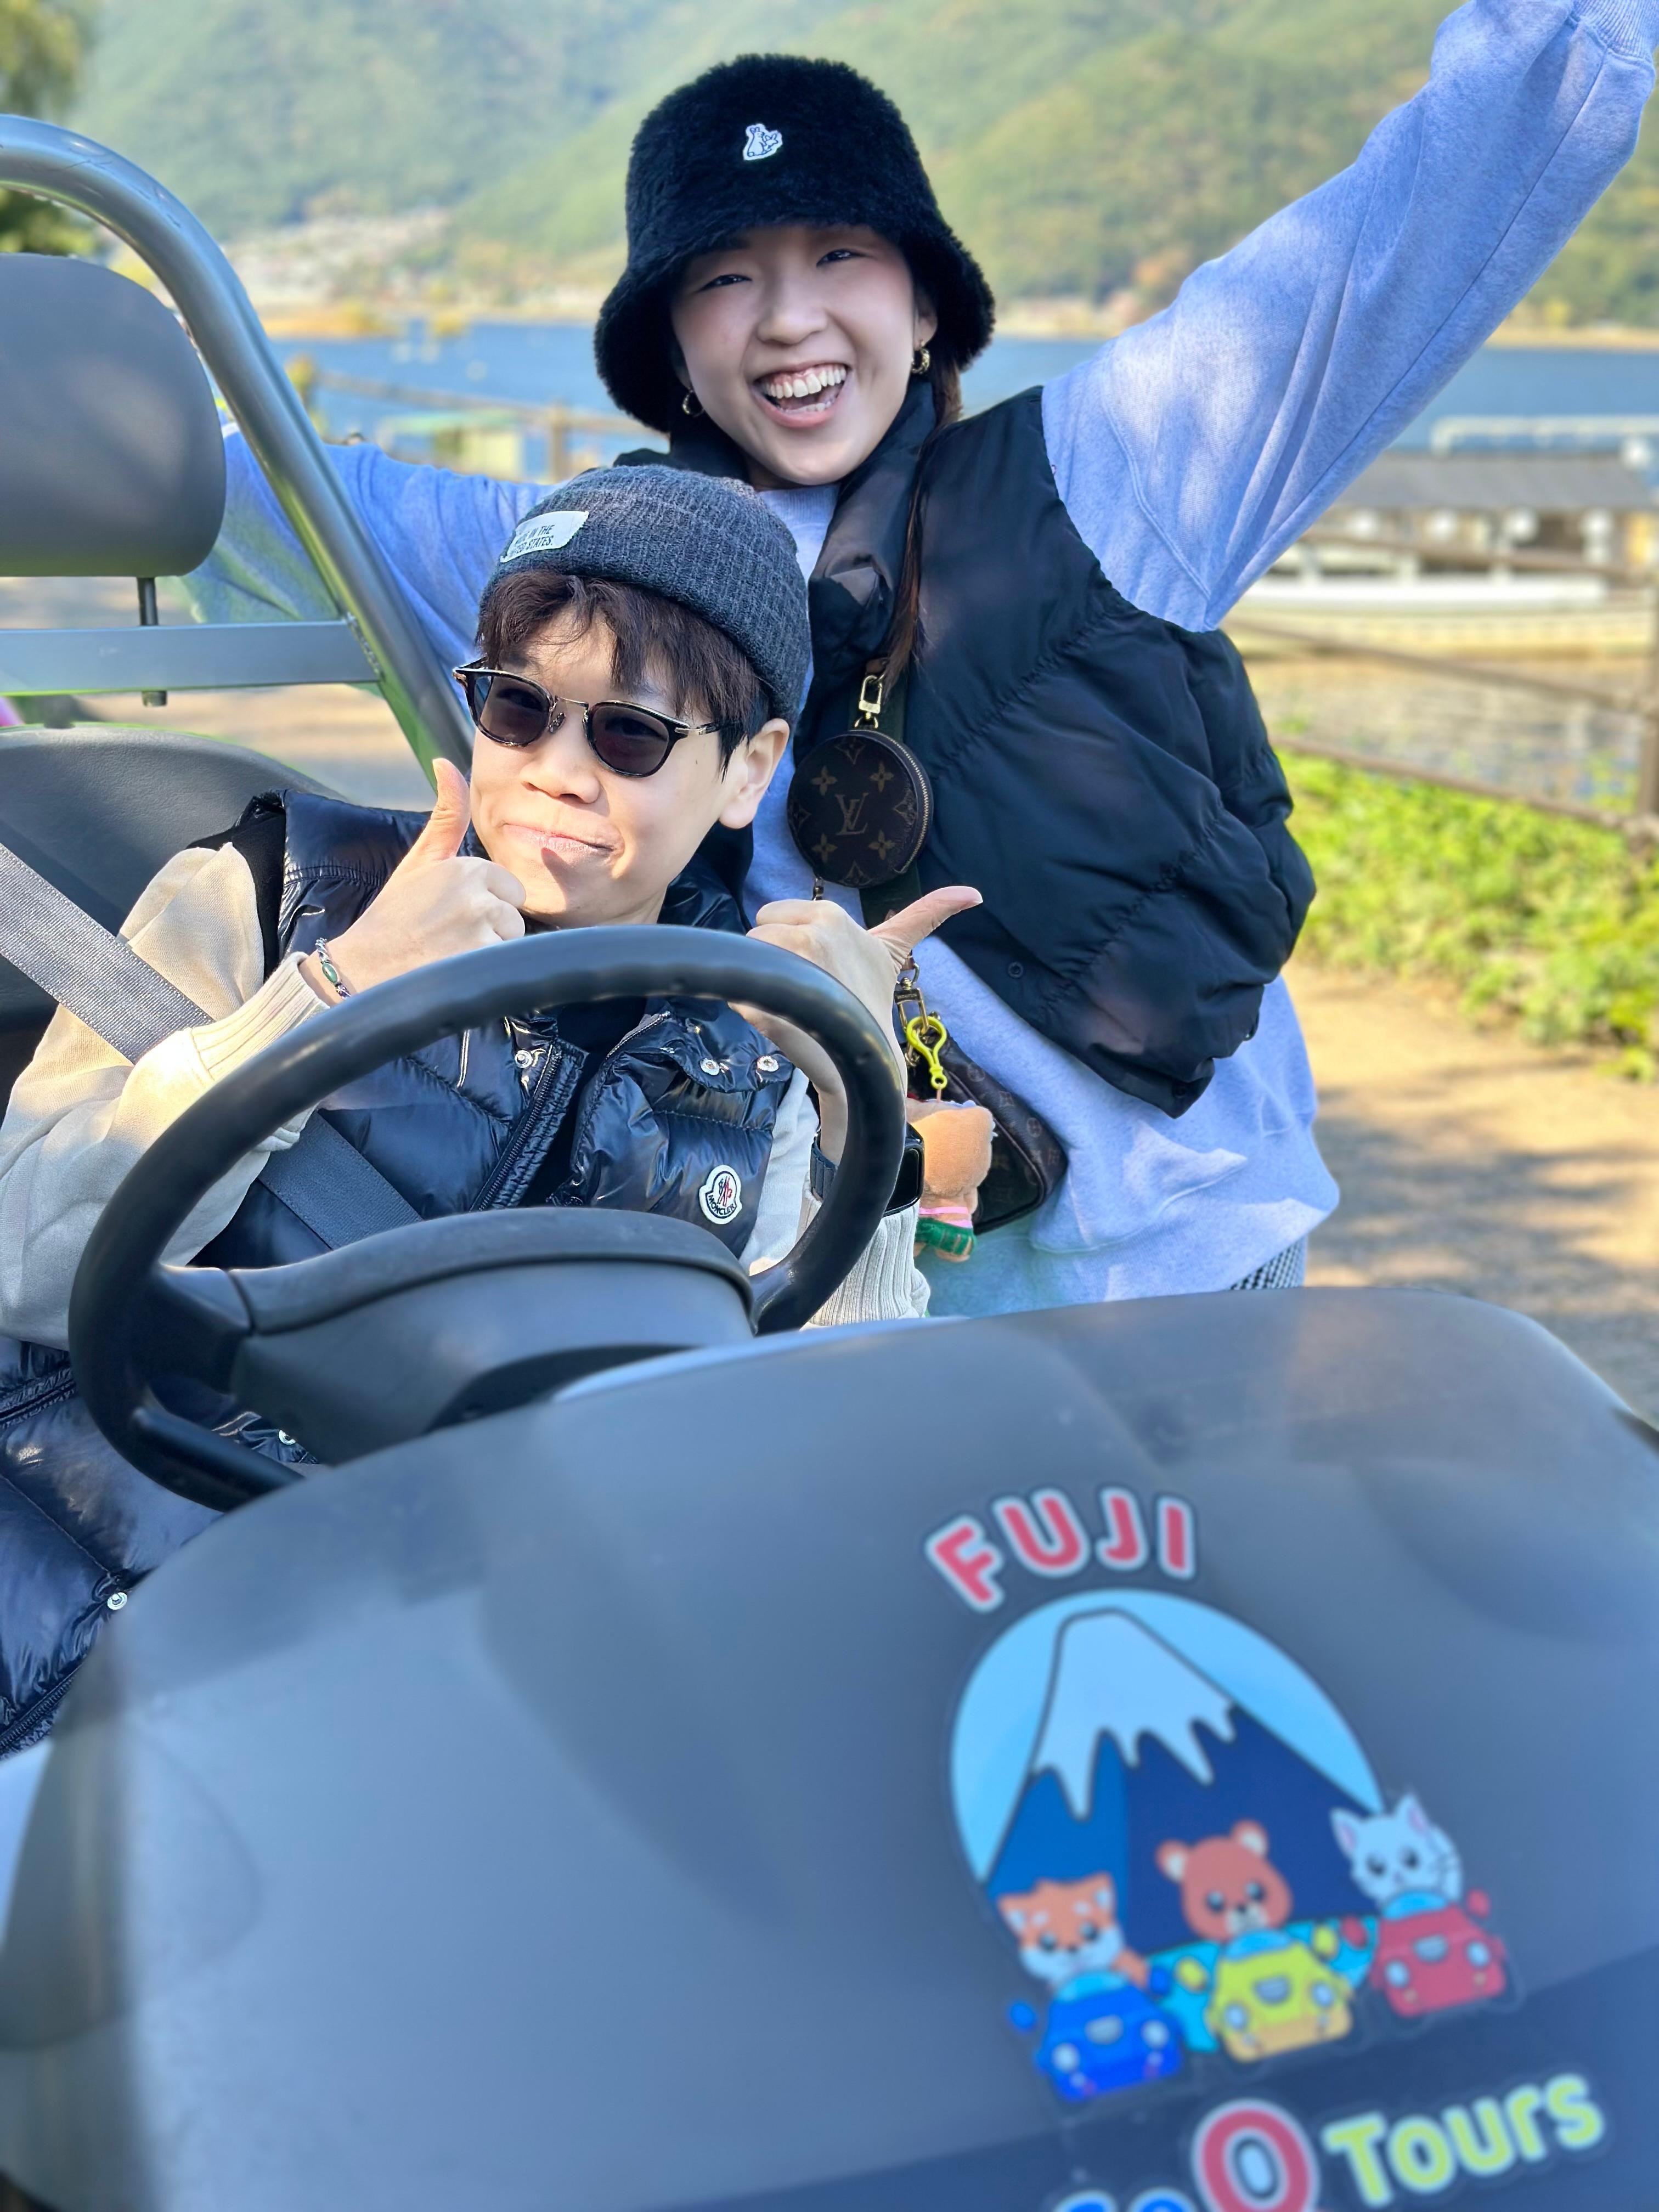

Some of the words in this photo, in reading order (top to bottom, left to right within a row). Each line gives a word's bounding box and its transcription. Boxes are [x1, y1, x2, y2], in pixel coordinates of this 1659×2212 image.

[538, 524, 555, 535] THE
[708, 1194, 735, 1215] MONCLER
[926, 1488, 1197, 1613] FUJI
[1323, 2074, 1603, 2206] Tours
